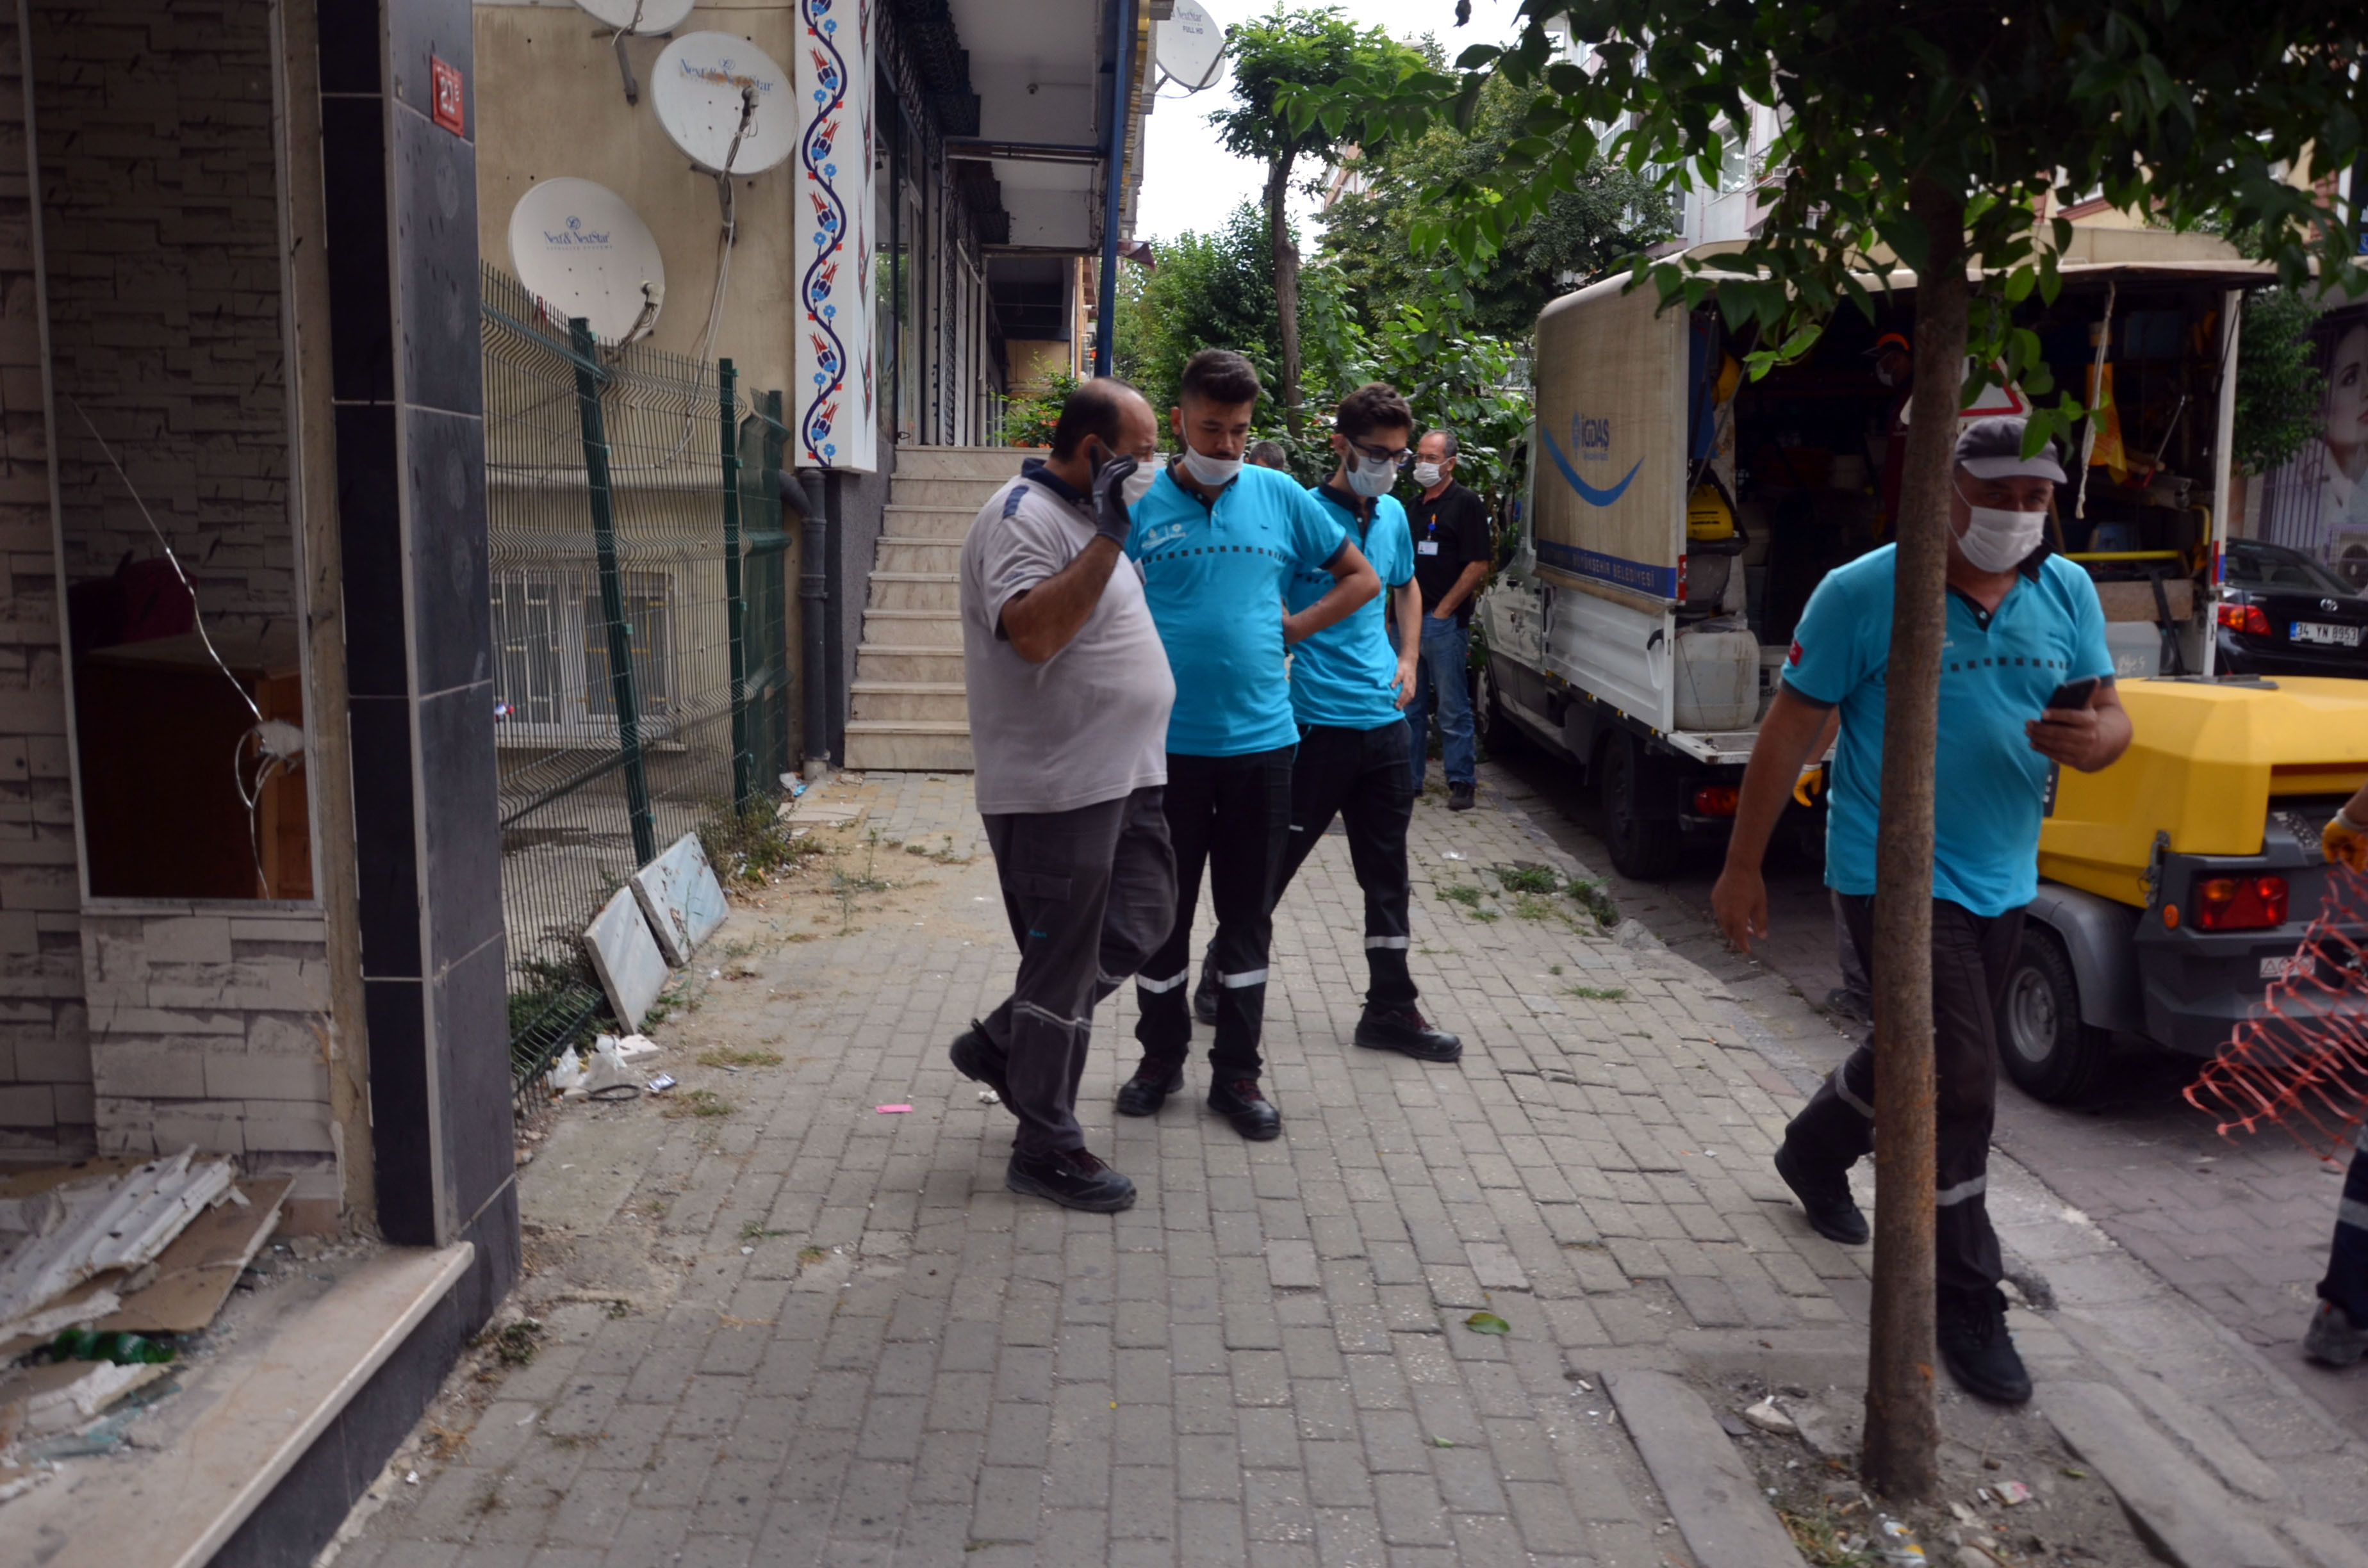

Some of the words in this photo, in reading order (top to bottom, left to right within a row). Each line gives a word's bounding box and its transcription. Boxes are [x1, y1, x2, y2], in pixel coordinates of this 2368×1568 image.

[679, 58, 705, 78] Next
[573, 231, 610, 244] NextStar
[2297, 624, 2308, 635] 34
